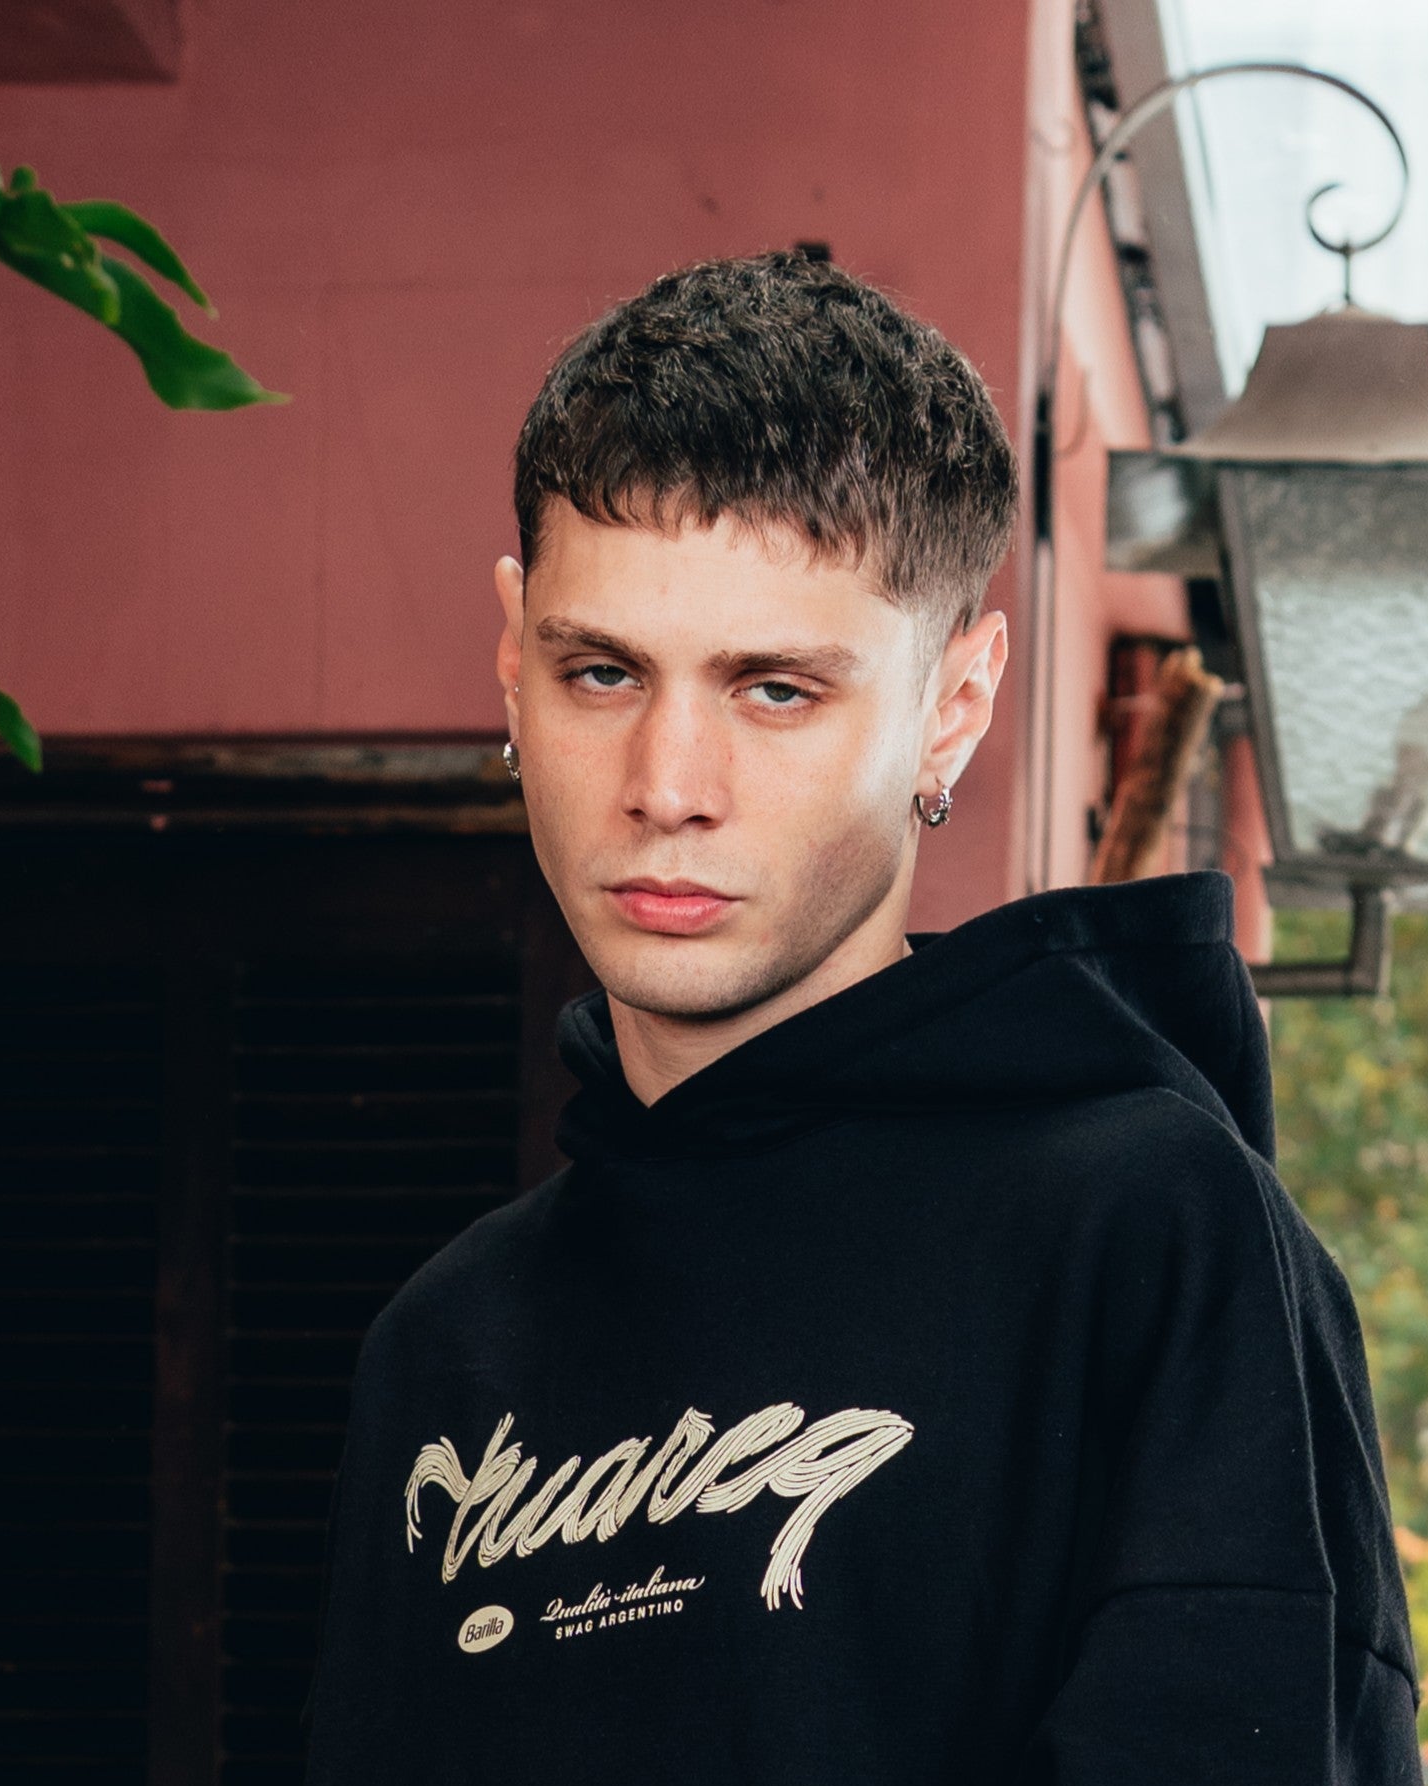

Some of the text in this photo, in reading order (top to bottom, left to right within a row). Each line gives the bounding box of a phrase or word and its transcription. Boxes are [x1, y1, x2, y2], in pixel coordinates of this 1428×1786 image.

[539, 1582, 612, 1621] Qualità
[555, 1599, 684, 1640] SWAG ARGENTINO
[464, 1617, 504, 1644] Barilla
